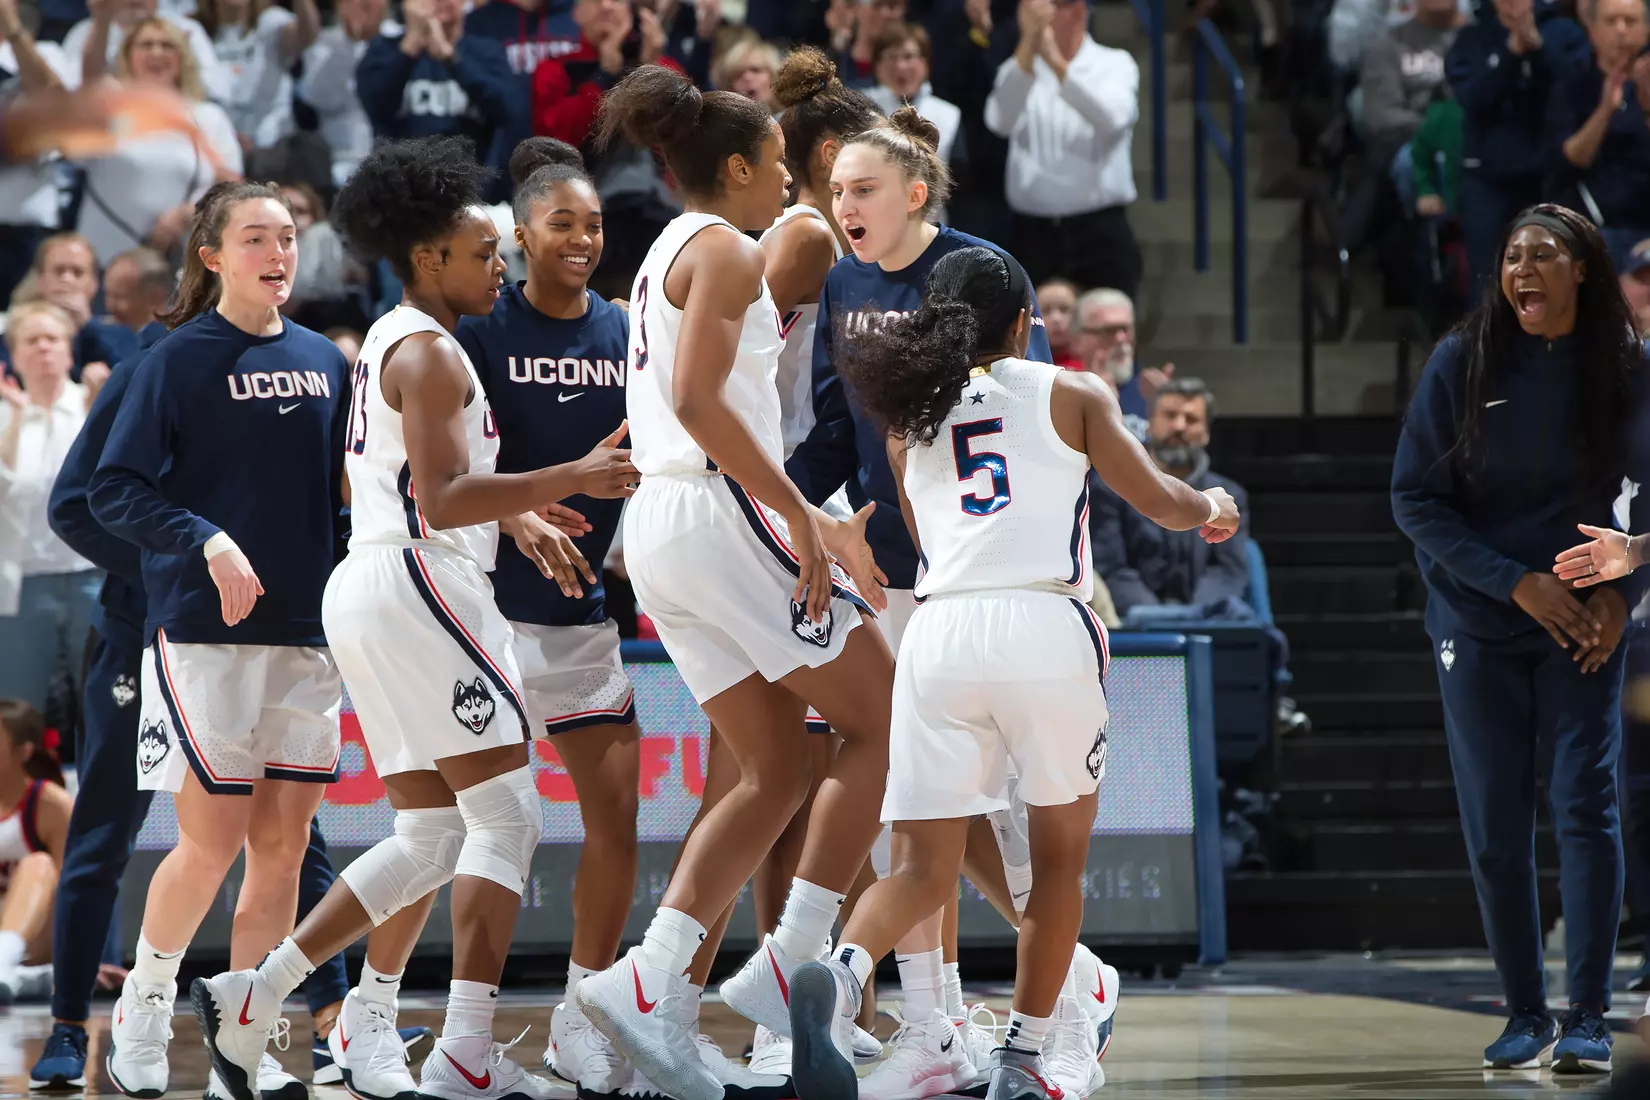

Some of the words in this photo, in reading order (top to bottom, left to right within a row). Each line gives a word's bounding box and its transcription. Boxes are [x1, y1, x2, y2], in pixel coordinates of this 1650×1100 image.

[227, 370, 331, 400] UCONN
[508, 356, 625, 387] UCONN
[345, 359, 369, 455] 13
[951, 417, 1012, 516] 5
